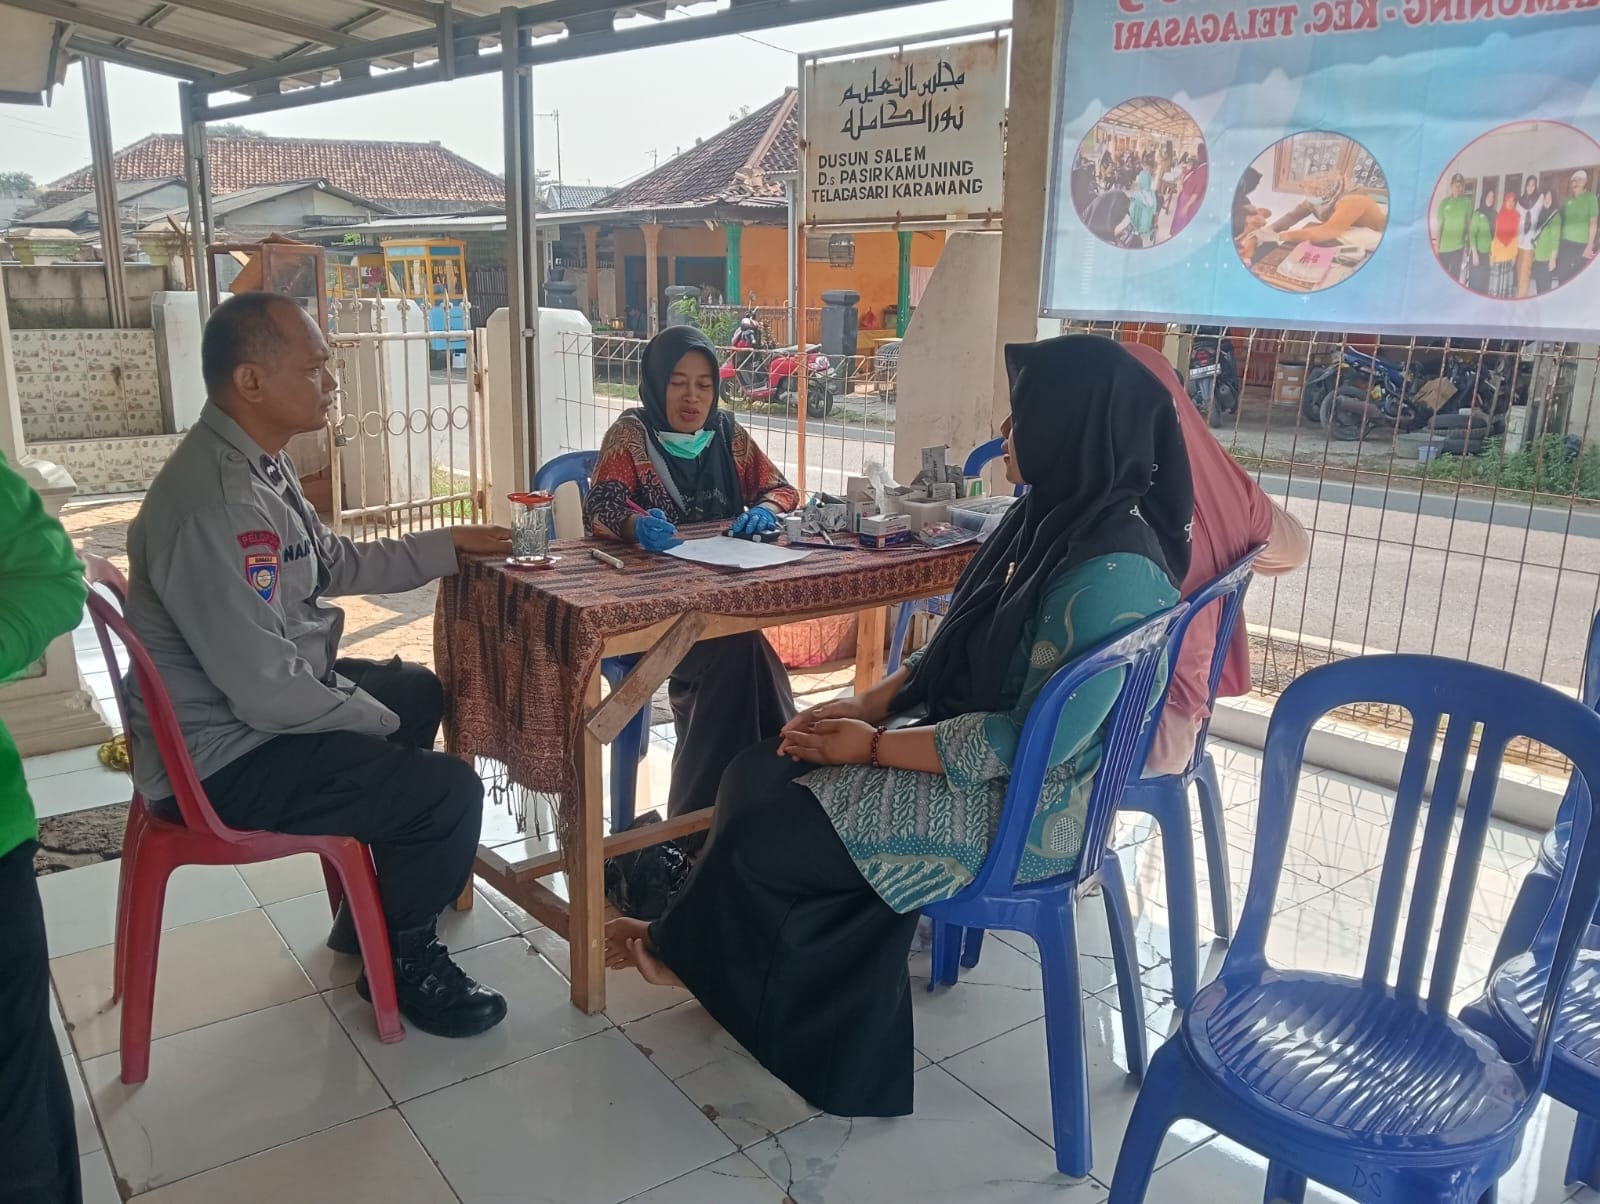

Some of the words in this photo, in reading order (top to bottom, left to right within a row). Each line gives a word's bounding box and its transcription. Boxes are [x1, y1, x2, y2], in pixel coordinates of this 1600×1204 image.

[818, 151, 869, 169] DUSUN
[874, 145, 926, 164] SALEM
[812, 185, 889, 203] TELAGASARI
[892, 178, 983, 199] KARAWANG
